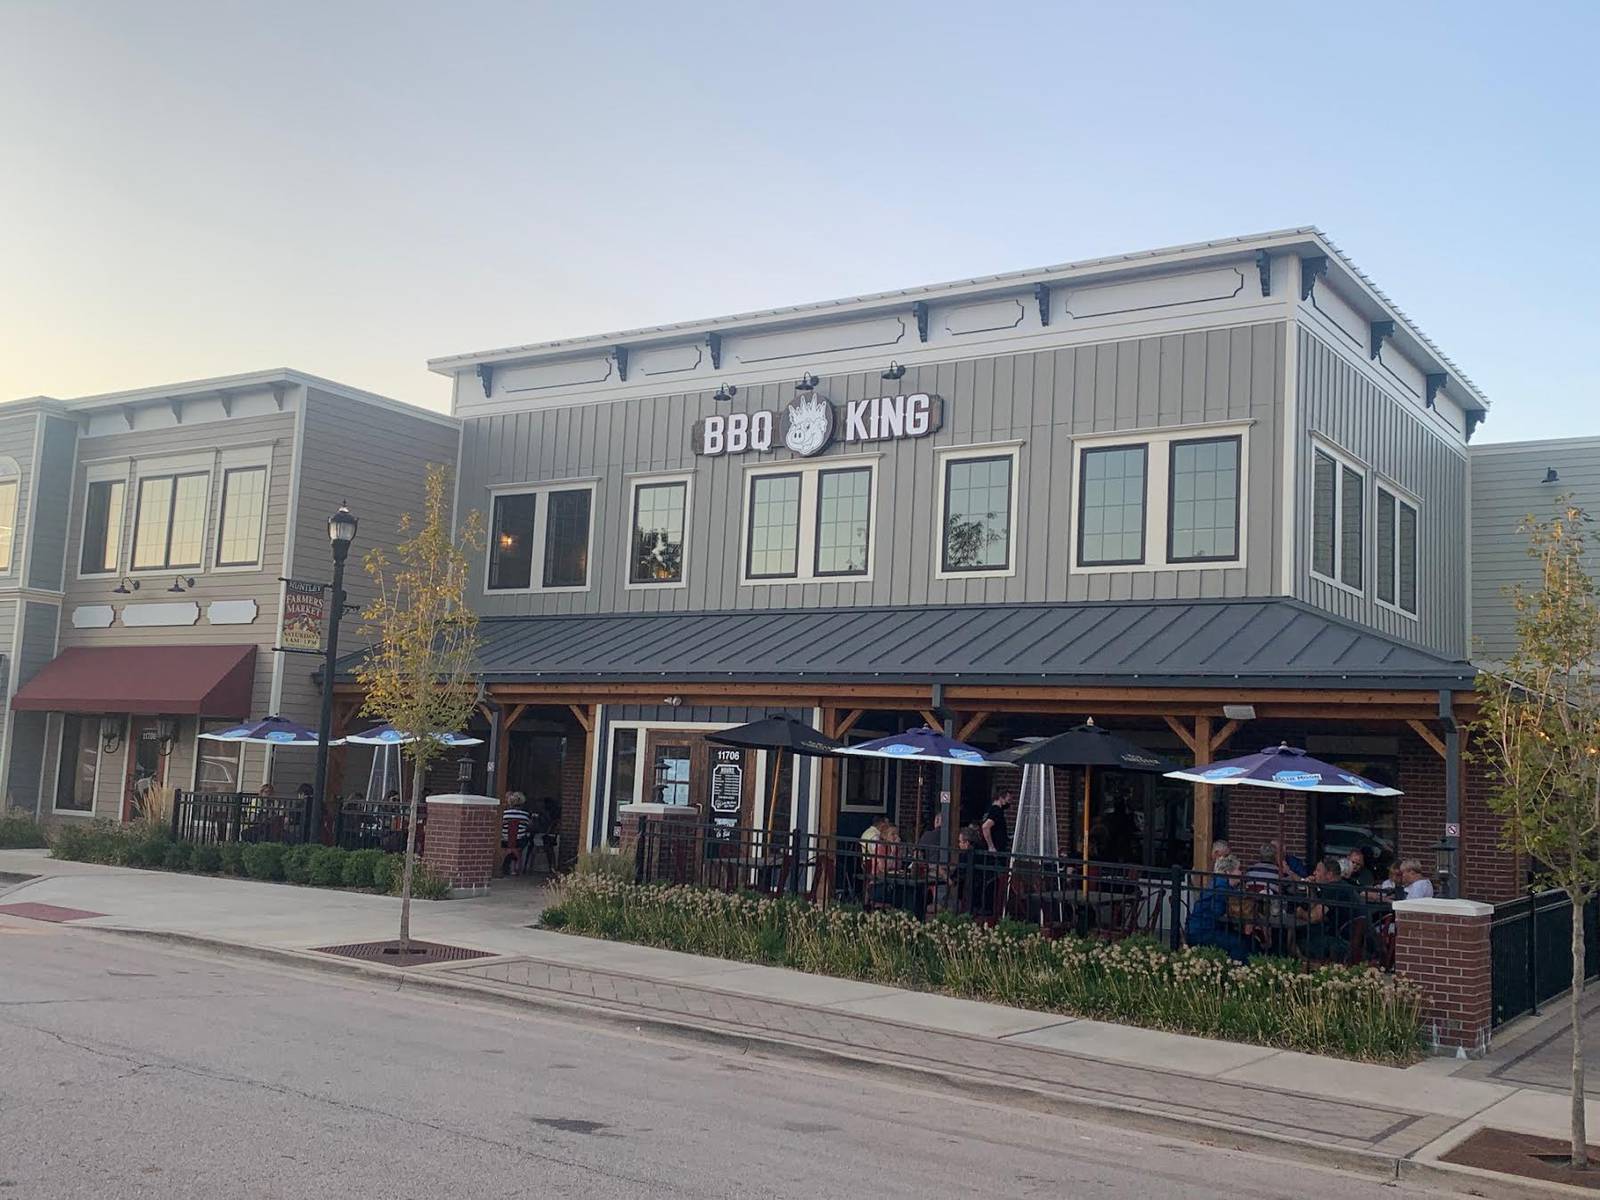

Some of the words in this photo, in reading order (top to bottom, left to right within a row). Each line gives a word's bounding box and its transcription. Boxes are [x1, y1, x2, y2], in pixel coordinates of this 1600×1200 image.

[703, 410, 773, 455] BBQ
[846, 393, 930, 441] KING
[286, 594, 324, 608] FARMERS
[286, 603, 322, 617] MARKET
[717, 751, 740, 760] 11706
